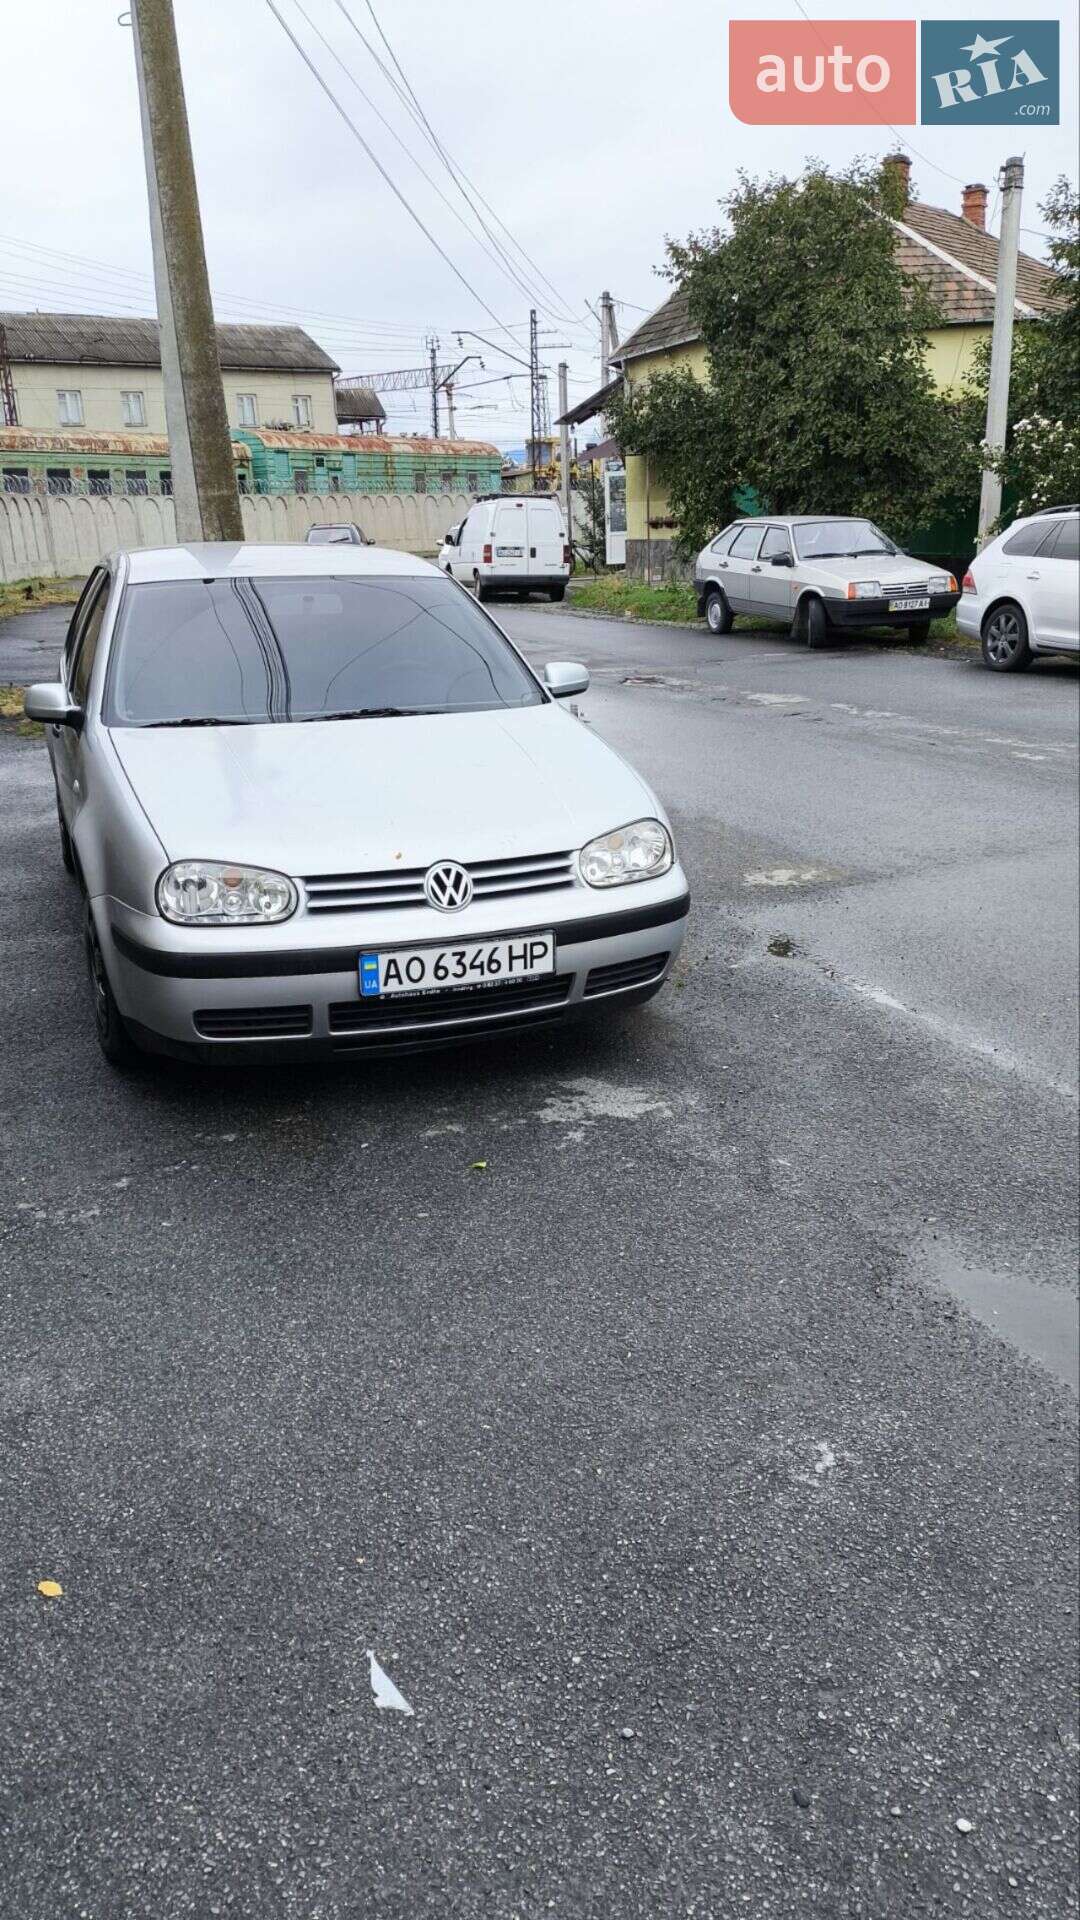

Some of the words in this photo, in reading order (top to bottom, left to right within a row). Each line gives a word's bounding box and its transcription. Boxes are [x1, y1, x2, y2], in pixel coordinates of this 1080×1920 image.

[383, 956, 426, 987] AO
[433, 946, 501, 981] 6346
[508, 941, 548, 972] HP
[364, 979, 378, 989] UA
